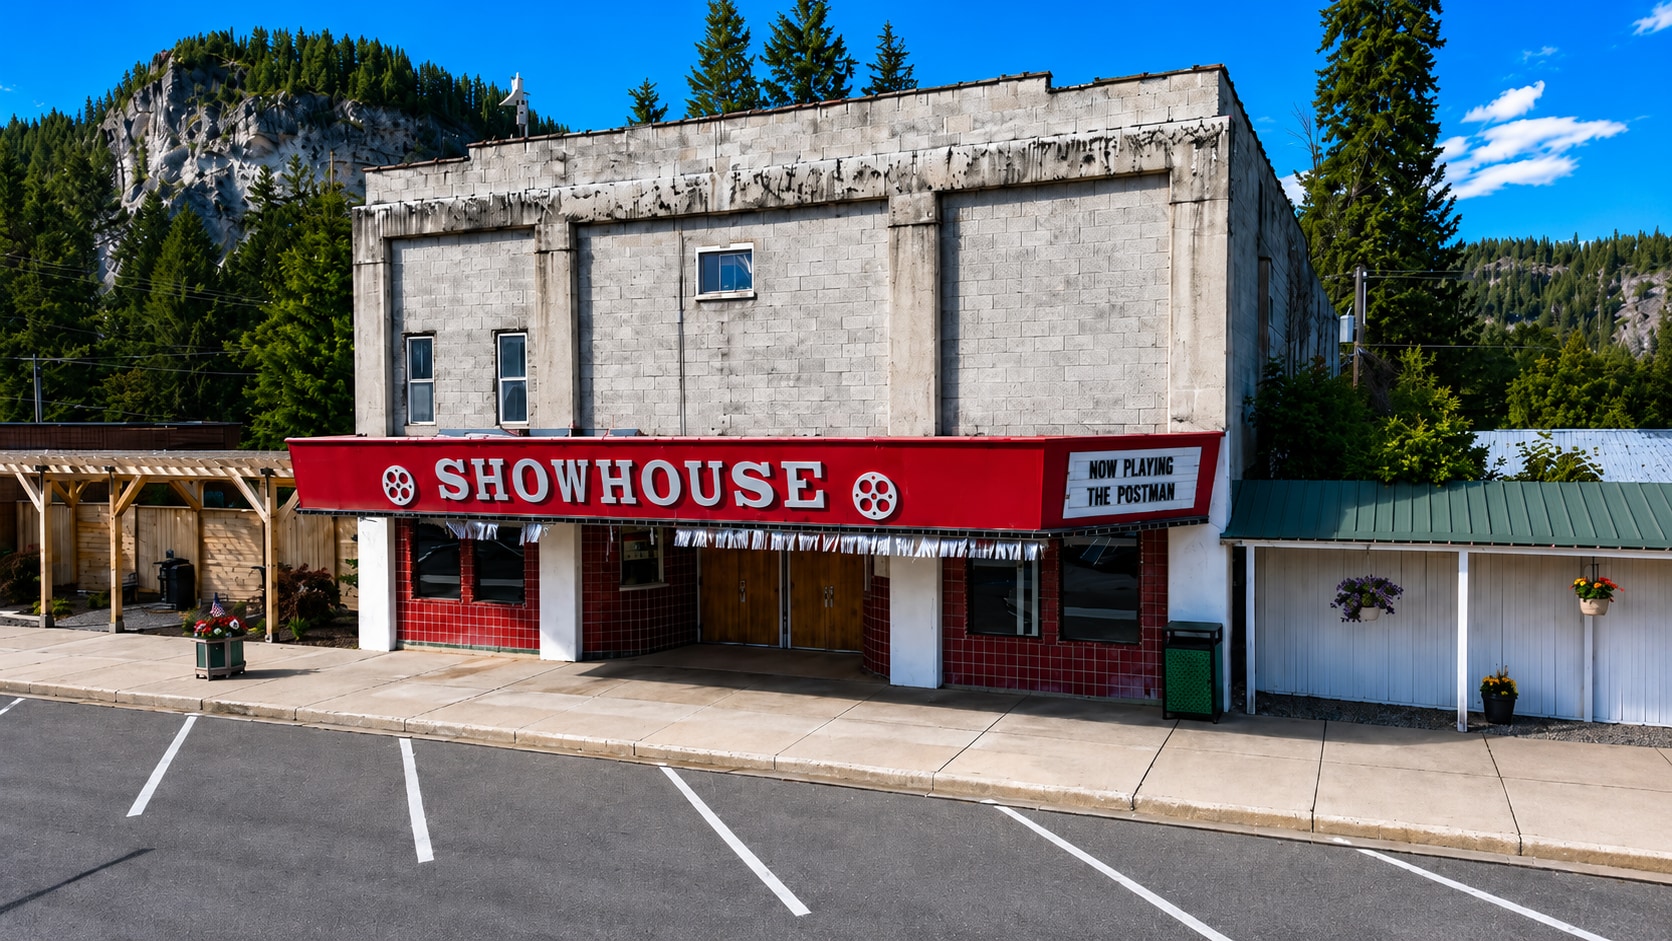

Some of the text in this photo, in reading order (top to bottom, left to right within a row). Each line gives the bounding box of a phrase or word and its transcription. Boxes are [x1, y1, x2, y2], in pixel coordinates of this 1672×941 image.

[1089, 456, 1174, 479] NOW PLAYING
[435, 457, 825, 509] SHOWHOUSE
[1087, 483, 1175, 506] THE POSTMAN
